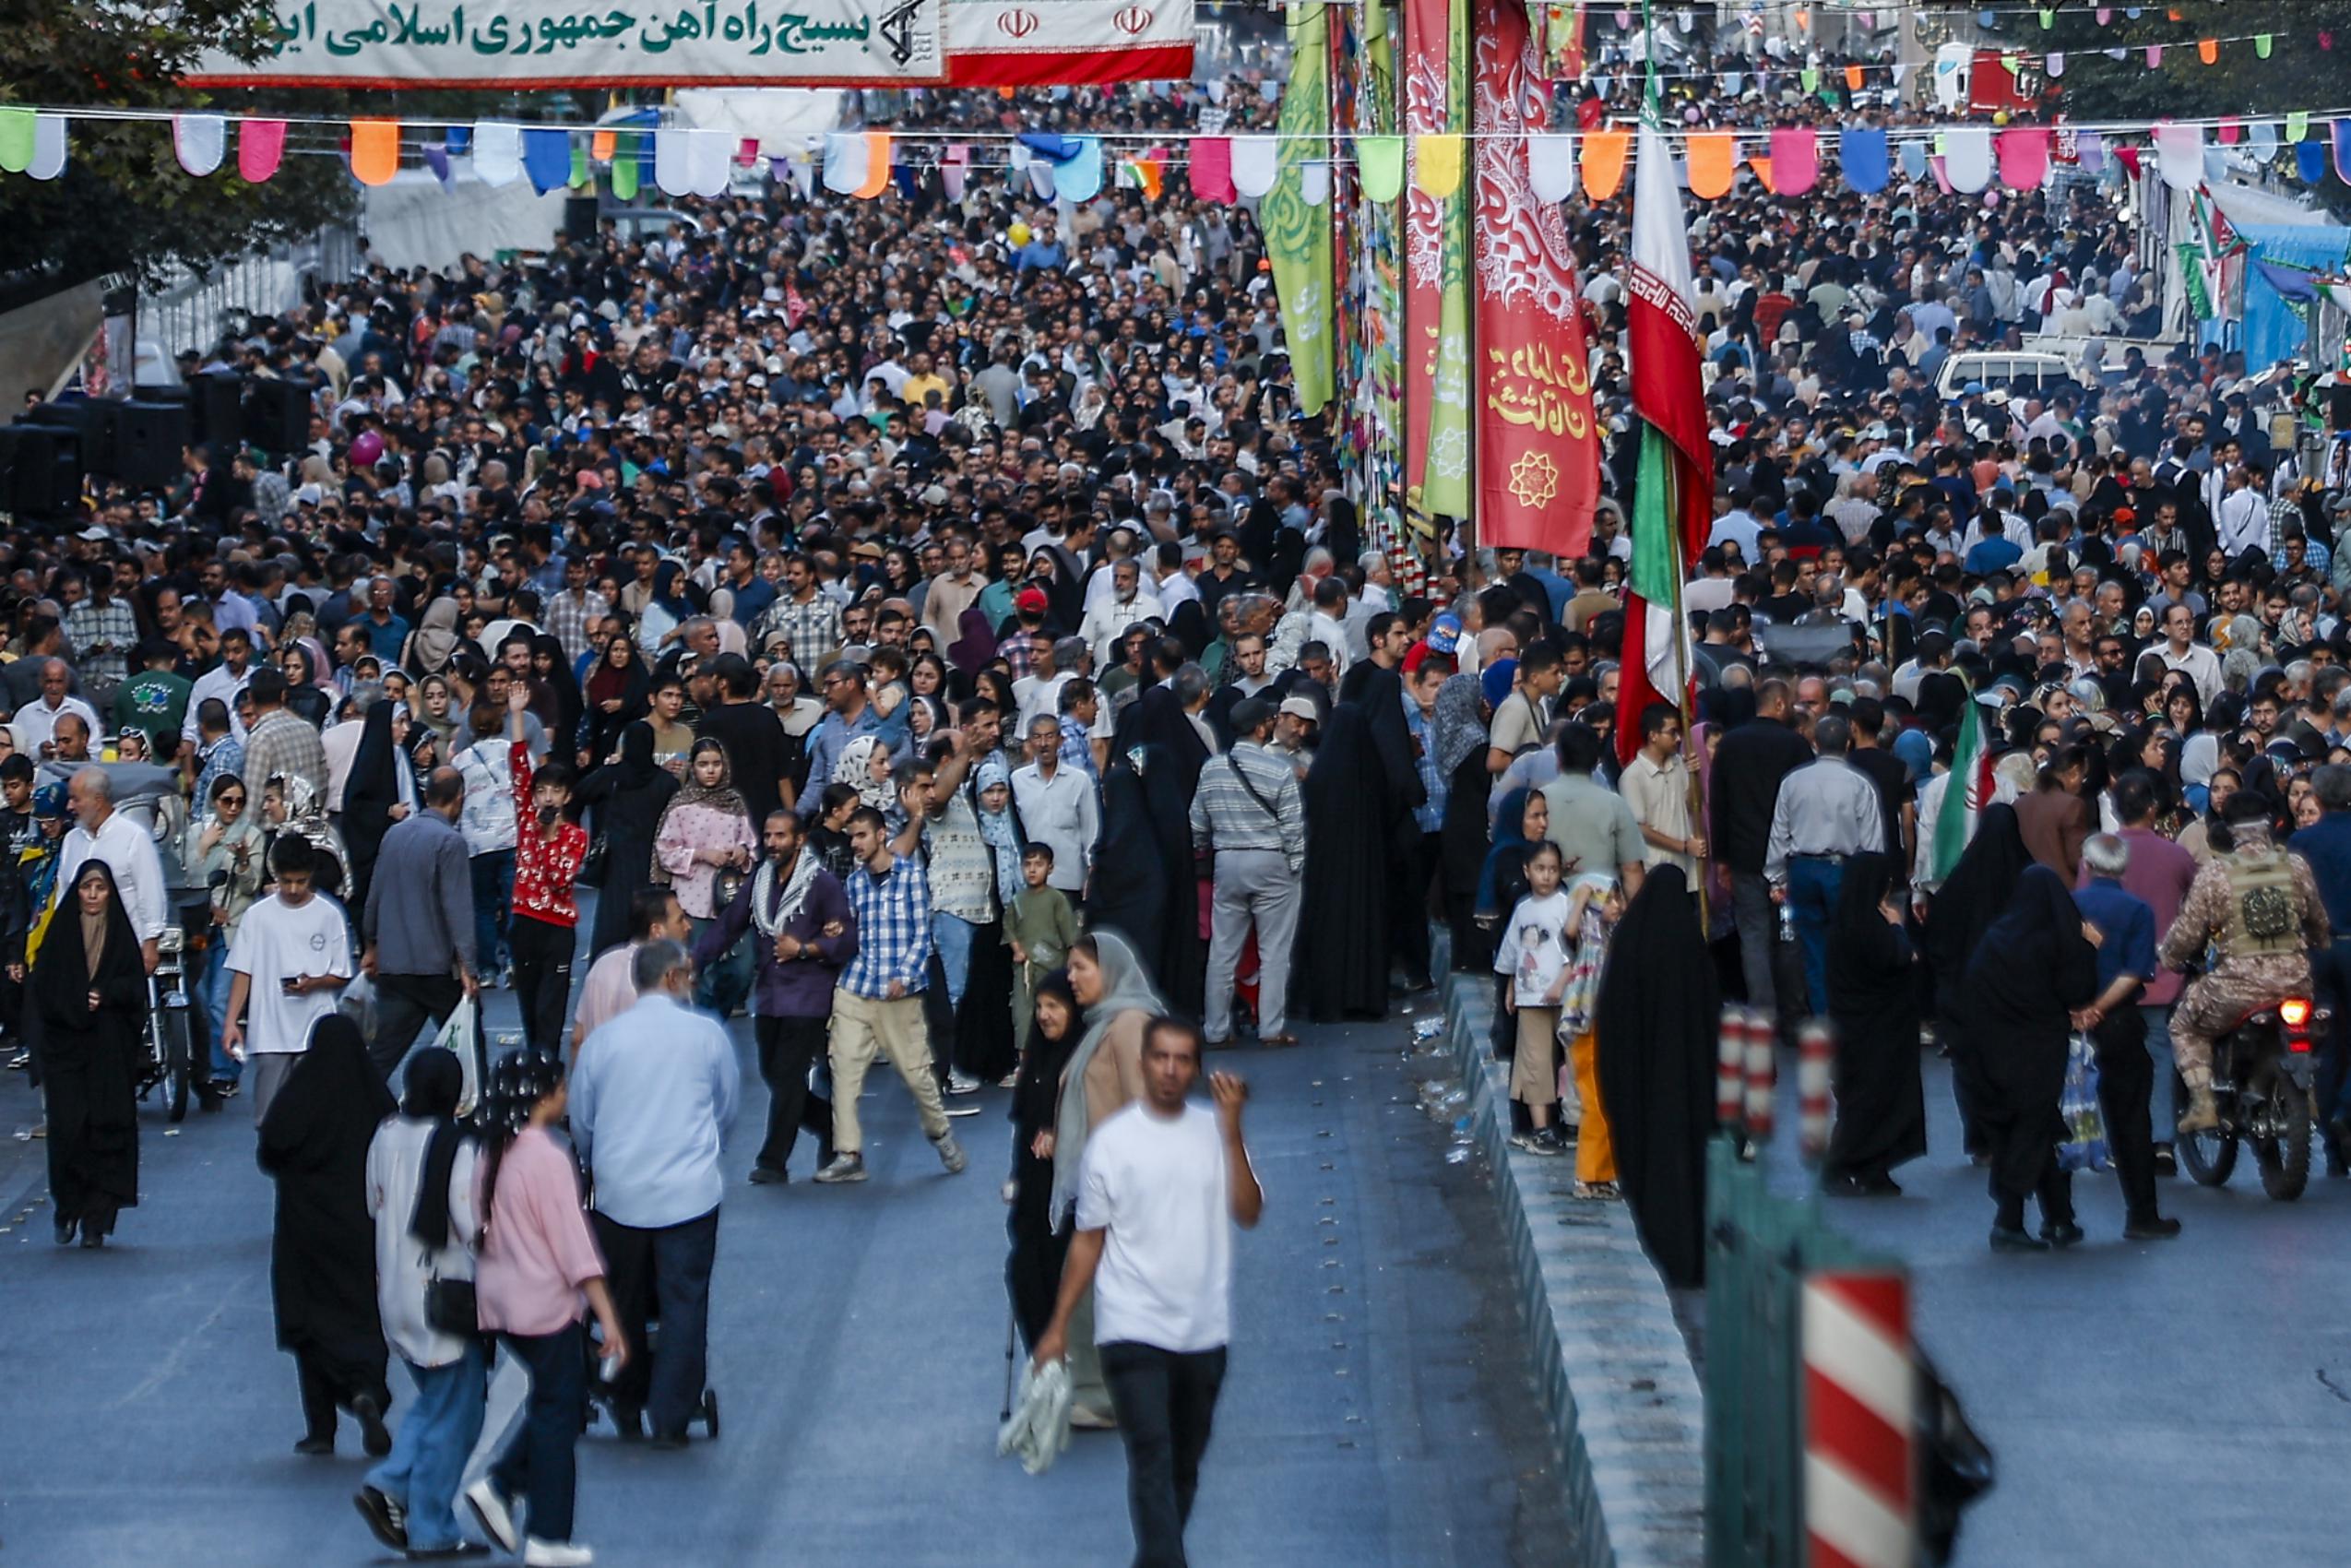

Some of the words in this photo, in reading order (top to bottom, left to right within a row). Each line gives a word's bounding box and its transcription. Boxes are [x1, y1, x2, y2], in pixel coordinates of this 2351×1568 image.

[325, 2, 465, 56] اسلامی
[470, 10, 636, 56] جمهوری
[639, 0, 718, 53] آهن
[722, 0, 771, 55] راه
[776, 13, 872, 55] بسیج
